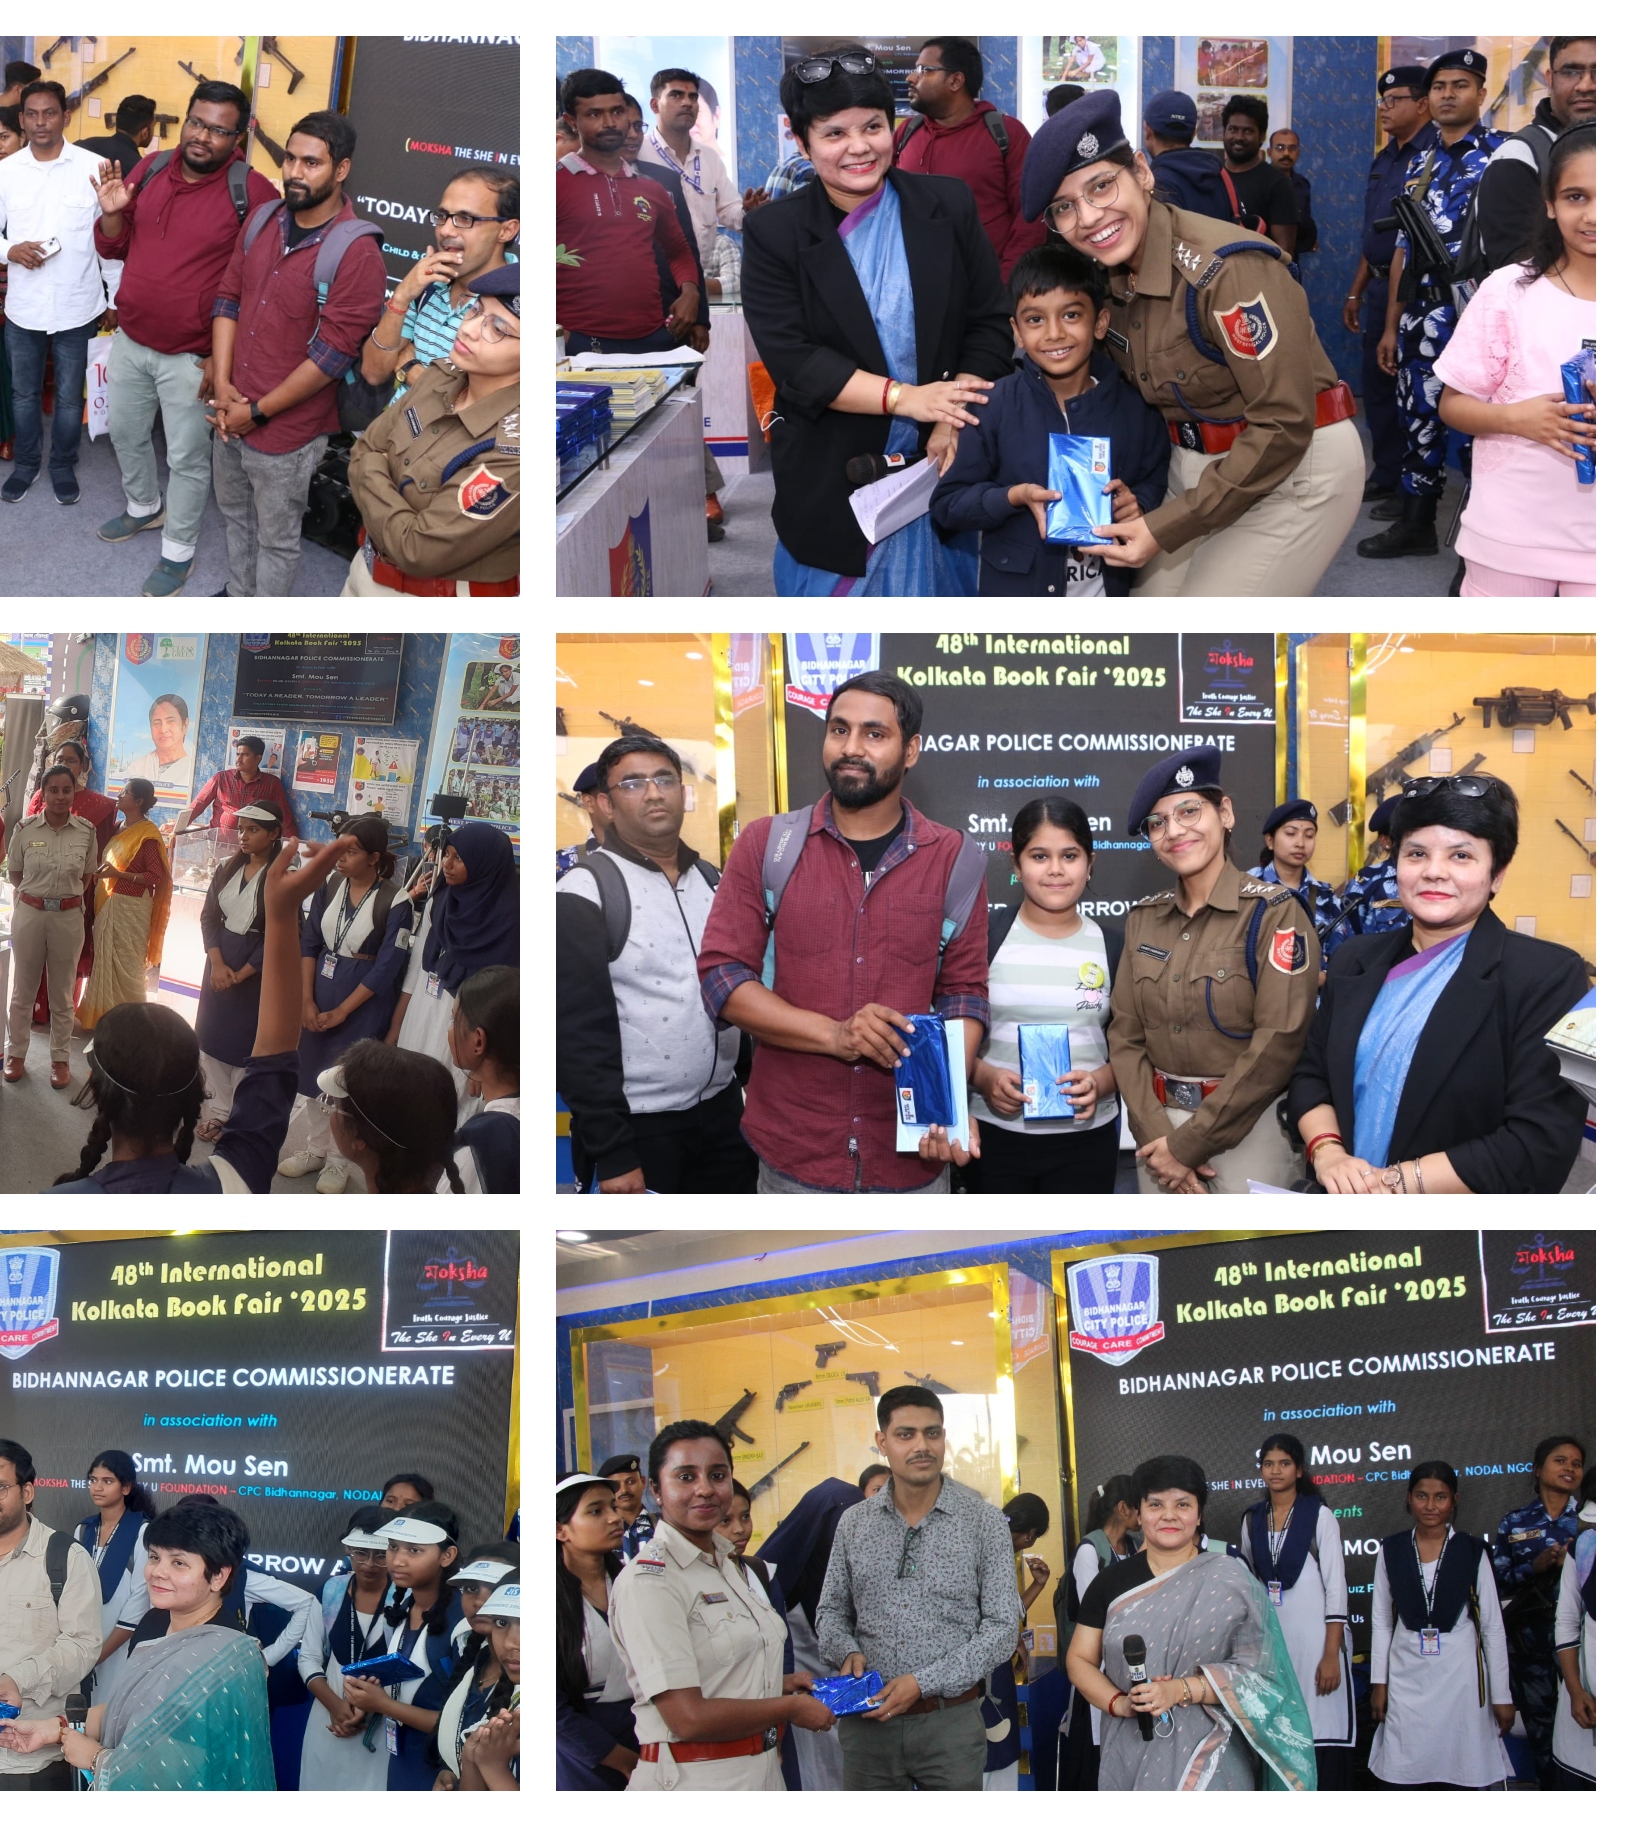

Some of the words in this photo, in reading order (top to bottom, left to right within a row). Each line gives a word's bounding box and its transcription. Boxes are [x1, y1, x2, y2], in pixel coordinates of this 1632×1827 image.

[454, 146, 471, 159] THE
[473, 149, 493, 162] SHE
[985, 634, 1130, 655] International
[801, 659, 866, 670] BIDHANNAGAR
[801, 674, 826, 686] CITY
[897, 666, 986, 686] Kolkata
[993, 666, 1050, 686] Book
[1055, 666, 1098, 686] Fair
[1186, 705, 1202, 717] The
[1205, 706, 1222, 717] She
[1237, 707, 1262, 720] Every
[986, 734, 1053, 751] POLICE
[1058, 734, 1236, 752] COMMISSIONERATE
[977, 775, 990, 788] in
[993, 775, 1070, 788] association
[1073, 774, 1100, 788] with
[968, 813, 1012, 833] Smt.
[161, 1253, 323, 1284] International
[1265, 1245, 1422, 1282] International
[71, 1298, 159, 1322] Kolkata
[167, 1294, 227, 1318] Book
[233, 1291, 282, 1315] Fair
[1083, 1301, 1146, 1316] BIDHANNAGAR
[1177, 1297, 1268, 1324] Kolkata
[1275, 1289, 1335, 1315] Book
[1341, 1284, 1387, 1308] Fair
[9, 1309, 45, 1321] POLICE
[1083, 1318, 1108, 1331] CITY
[1110, 1315, 1149, 1330] POLICE
[1492, 1313, 1513, 1326] The
[1515, 1311, 1537, 1324] She
[1540, 1309, 1553, 1321] In
[1556, 1307, 1588, 1321] Every
[0, 1334, 28, 1342] CARE
[390, 1331, 411, 1344] The
[414, 1331, 438, 1344] She
[442, 1330, 457, 1342] In
[460, 1329, 495, 1344] Every
[498, 1328, 513, 1341] U
[1071, 1337, 1099, 1350] COURAGE
[1102, 1339, 1133, 1350] CARE
[12, 1370, 149, 1388] BIDHANNAGAR
[155, 1368, 226, 1388] POLICE
[232, 1365, 455, 1387] COMMISSIONERATE
[1119, 1367, 1265, 1395] BIDHANNAGAR
[1271, 1359, 1342, 1383] POLICE
[1348, 1341, 1556, 1377] COMMISSIONERATE
[143, 1413, 155, 1427] in
[160, 1413, 242, 1427] association
[247, 1413, 278, 1427] with
[1263, 1408, 1276, 1422] in
[1280, 1403, 1362, 1421] association
[1366, 1400, 1396, 1415] with
[1310, 1444, 1362, 1466] Mou
[1369, 1441, 1412, 1462] Sen
[131, 1452, 177, 1474] Smt.
[185, 1453, 236, 1476] Mou
[244, 1455, 288, 1477] Sen
[1211, 1479, 1230, 1491] SHE
[1365, 1470, 1389, 1482] CPC
[1465, 1463, 1504, 1477] NODAL
[71, 1479, 87, 1489] THE
[160, 1483, 228, 1496] FOUNDATION
[238, 1486, 261, 1498] CPC
[1351, 1613, 1365, 1623] Us
